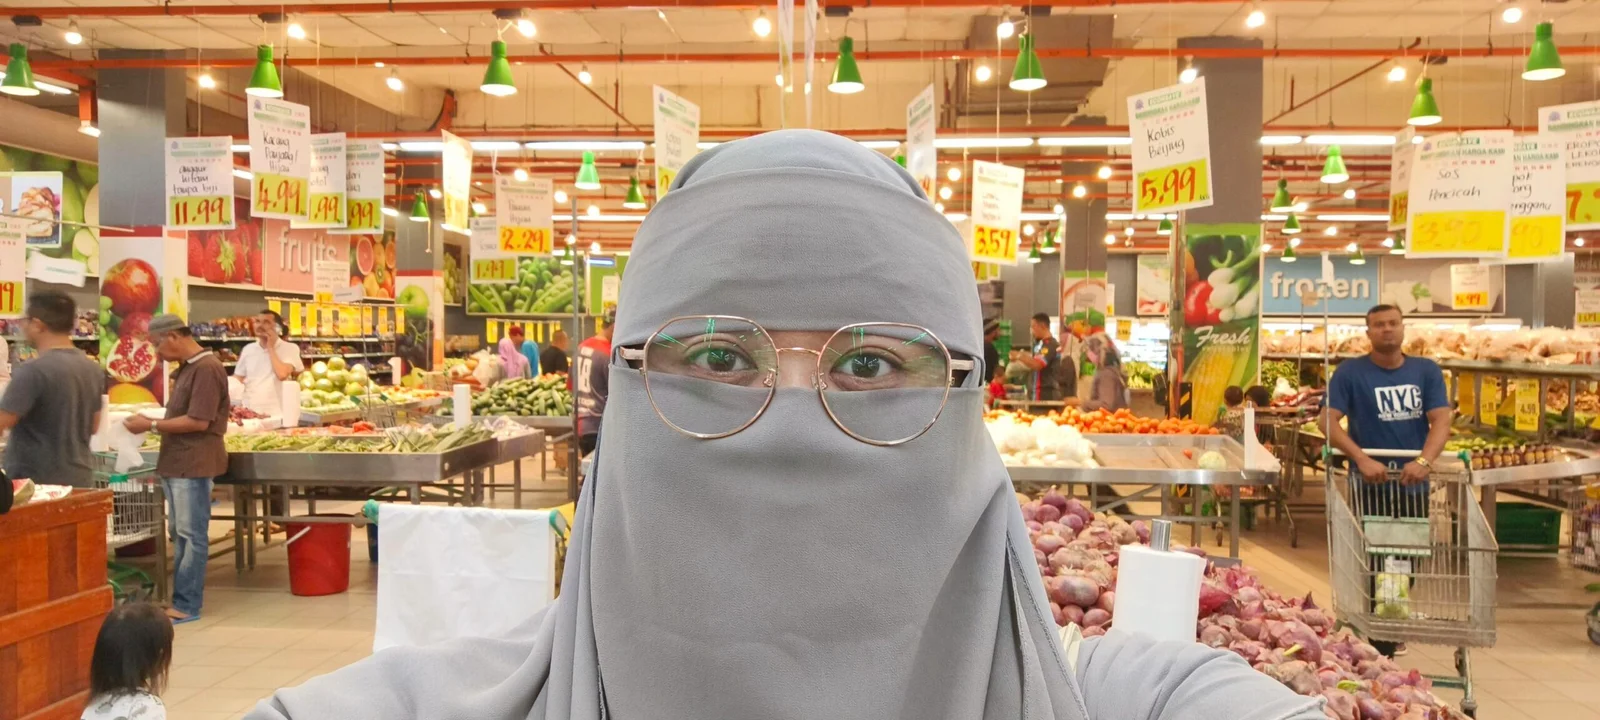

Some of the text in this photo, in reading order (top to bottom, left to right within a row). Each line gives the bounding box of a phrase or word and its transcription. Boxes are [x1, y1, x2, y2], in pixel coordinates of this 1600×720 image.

[257, 178, 301, 214] 4.99
[1141, 166, 1196, 207] 5.99
[175, 197, 225, 226] 11.99
[502, 228, 544, 253] 2.29
[976, 226, 1011, 258] 3.59
[1269, 270, 1370, 300] frozen
[1194, 325, 1250, 348] Fresh
[1379, 387, 1422, 412] NYC
